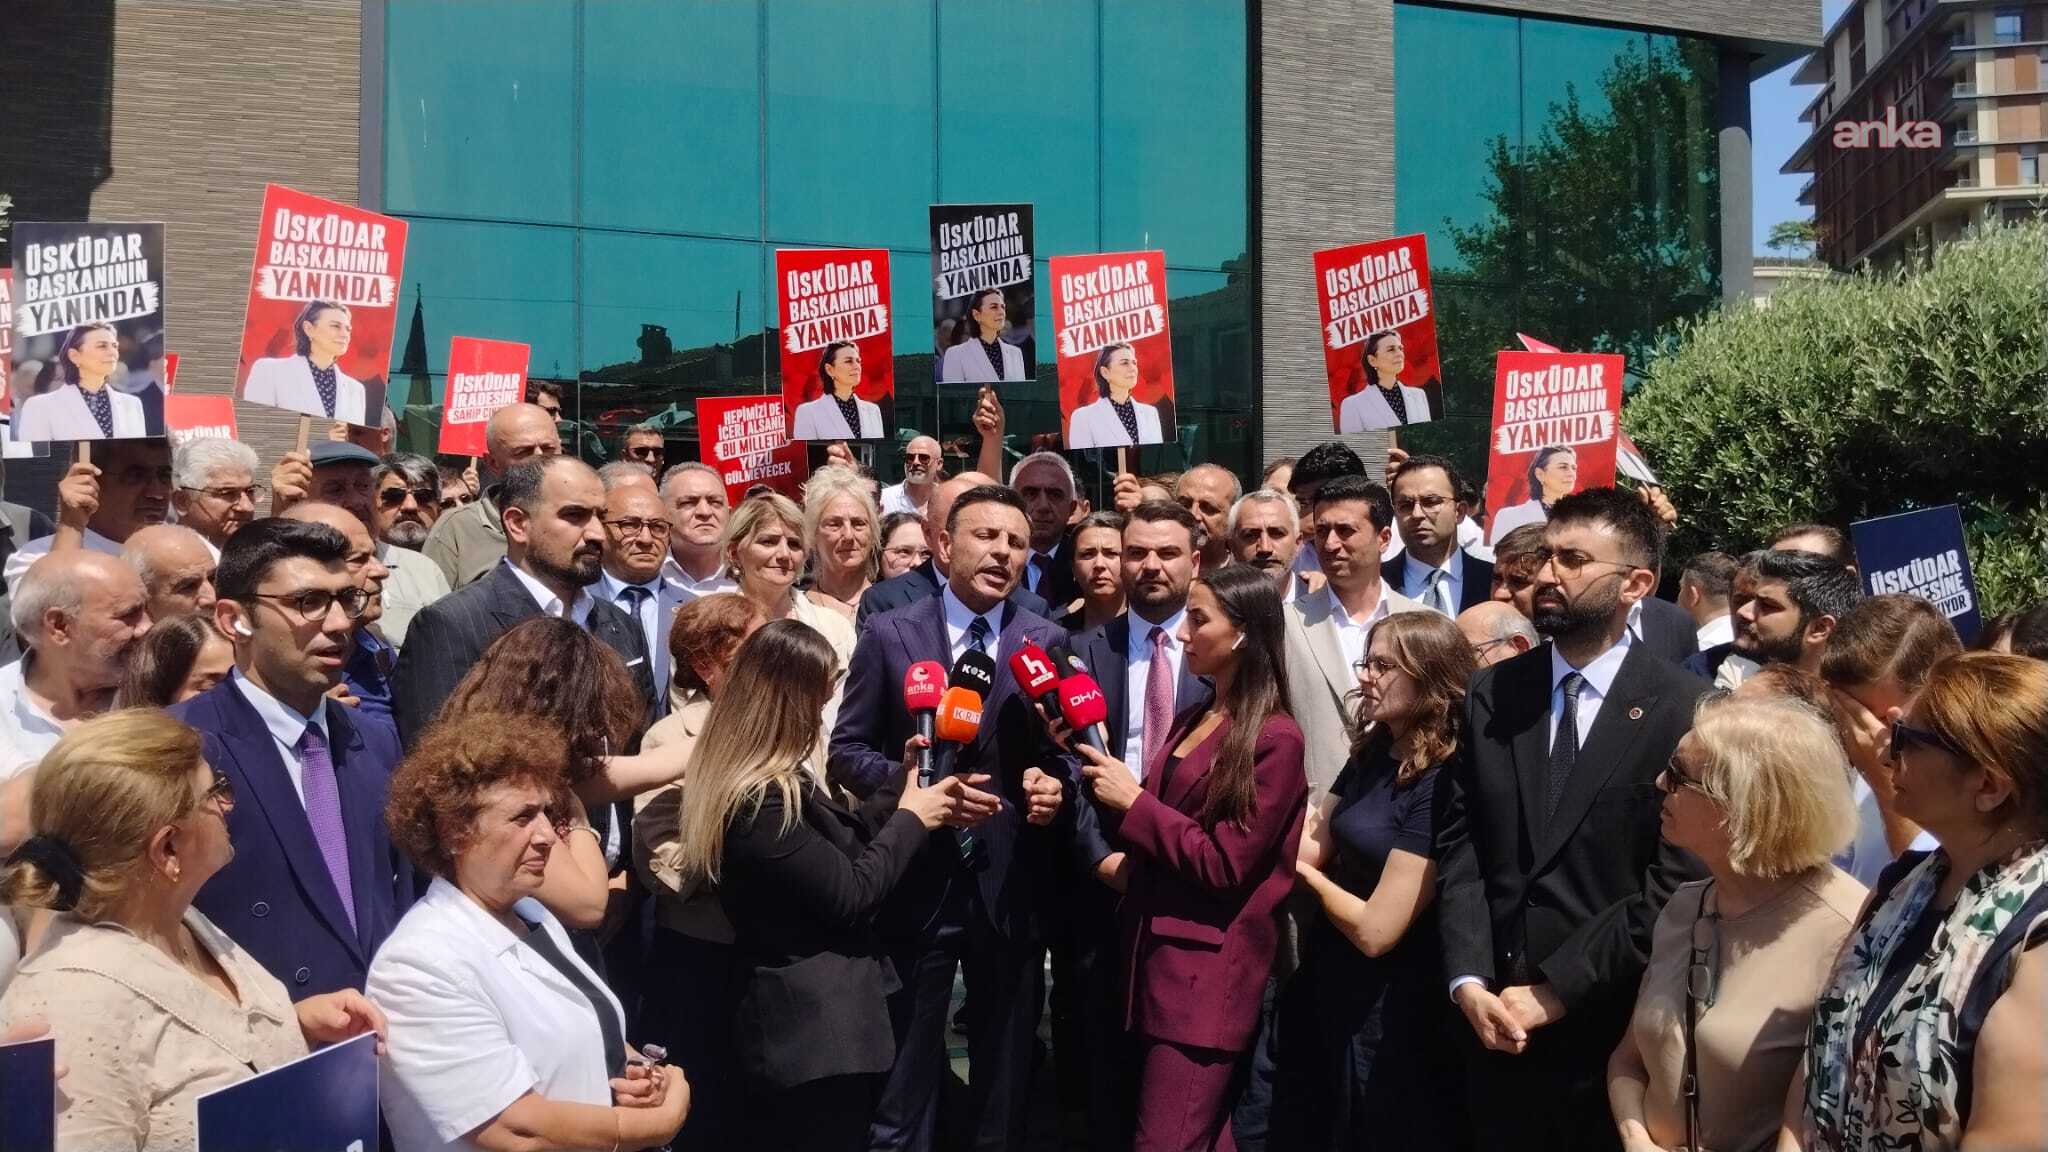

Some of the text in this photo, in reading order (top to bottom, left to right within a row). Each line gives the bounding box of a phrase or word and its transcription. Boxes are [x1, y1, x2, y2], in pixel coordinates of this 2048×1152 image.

[273, 208, 386, 251] ÜSKÜDAR
[940, 212, 1021, 250] ÜSKÜDAR
[25, 233, 143, 276] ÜSKÜDAR
[268, 241, 389, 274] BAŞKANININ
[941, 235, 1024, 272] BAŞKANININ
[25, 259, 149, 302] BAŞKANININ
[272, 269, 383, 304] YANINDA
[787, 260, 874, 300] ÜSKÜDAR
[945, 258, 1024, 294] YANINDA
[1061, 260, 1149, 304] ÜSKÜDAR
[1325, 247, 1413, 298] ÜSKÜDAR
[30, 286, 147, 332] YANINDA
[789, 284, 879, 323] BAŞKANININ
[1063, 284, 1155, 326] BAŞKANININ
[1329, 269, 1419, 320] BAŞKANININ
[794, 309, 880, 349] YANINDA
[1069, 311, 1157, 353] YANINDA
[1335, 295, 1421, 342] YANINDA
[453, 372, 520, 393] ÜSKÜDAR
[1505, 363, 1604, 400] ÜSKÜDAR
[723, 402, 781, 425] HEPİMİZİ DE
[1503, 388, 1607, 424] BAŞKANININ
[174, 424, 232, 444] SKÜDAR
[747, 415, 785, 436] ALSANIZ
[1506, 417, 1604, 450] YANINDA
[722, 441, 736, 458] BU
[740, 449, 773, 471] YÜZÜ
[725, 461, 792, 486] GÜLMEYECEK
[1870, 549, 1962, 596] ÜSKÜDAR
[907, 681, 935, 694] anka
[962, 663, 991, 685] KOZA
[1070, 689, 1102, 707] DHA
